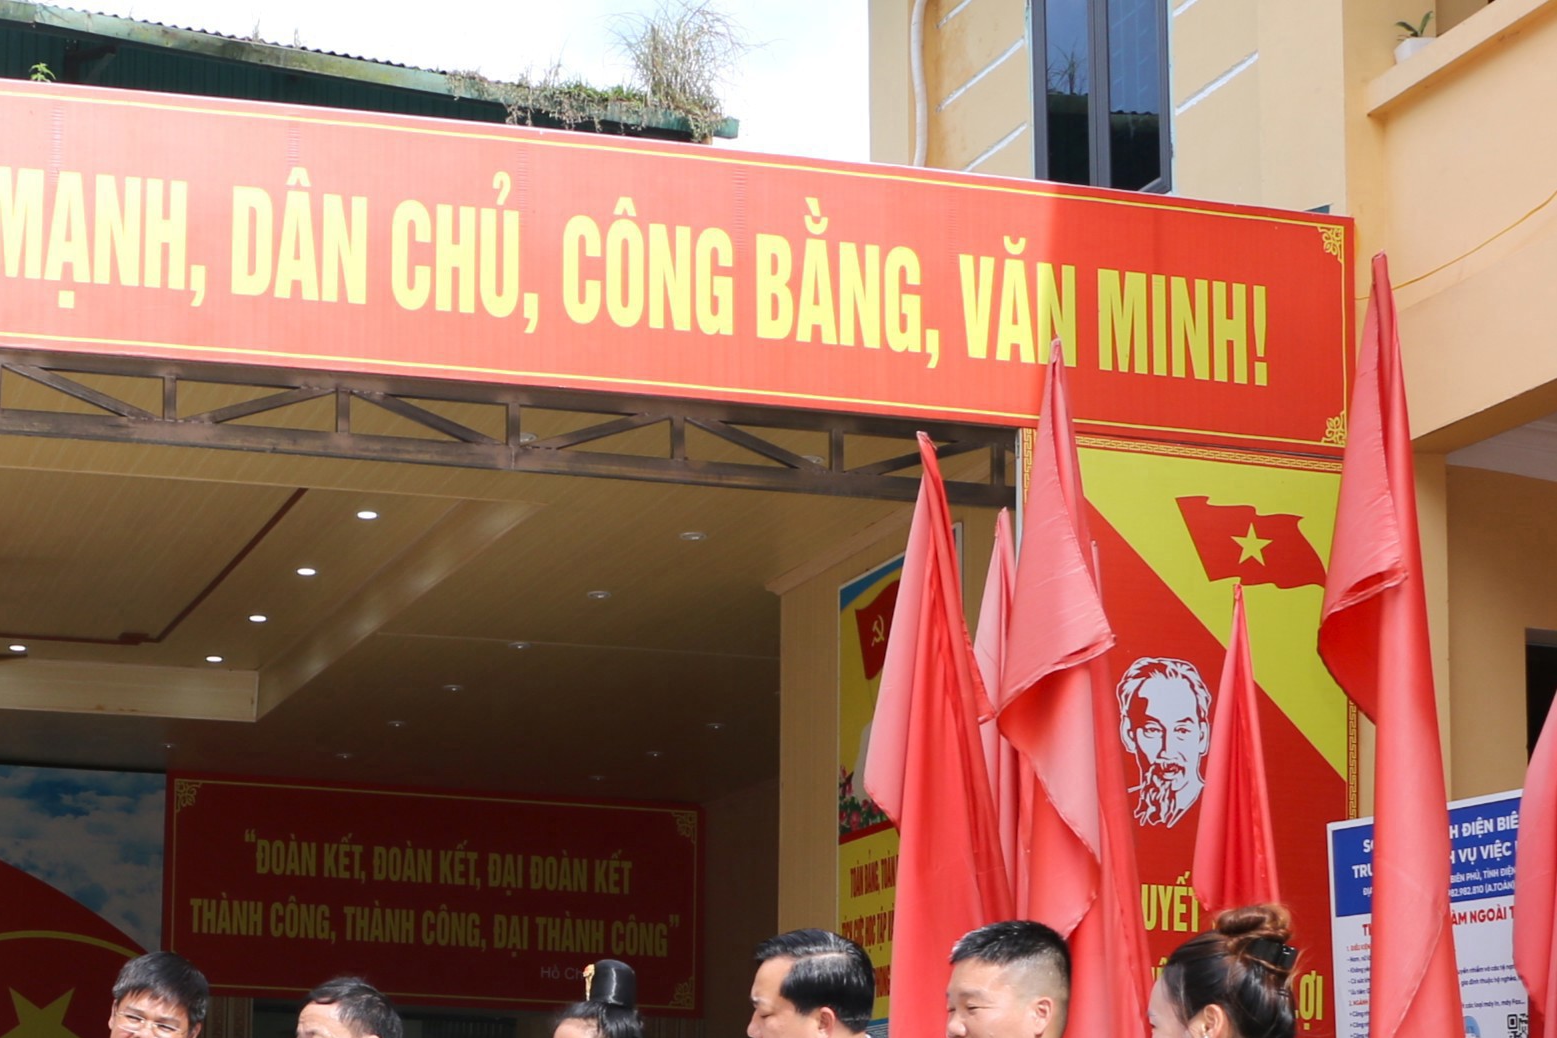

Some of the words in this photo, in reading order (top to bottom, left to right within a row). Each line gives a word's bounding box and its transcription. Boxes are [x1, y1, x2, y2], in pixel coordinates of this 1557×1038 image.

[232, 166, 369, 303] DÂN
[391, 172, 540, 333] CHỦ,
[563, 197, 734, 335] CÔNG
[756, 197, 940, 368] BẰNG,
[960, 234, 1077, 367] VĂN
[1098, 268, 1268, 387] MINH!
[1461, 816, 1494, 838] ĐIỆN
[1496, 810, 1520, 832] BIÊ
[1480, 839, 1512, 861] VIỆC
[324, 833, 366, 884] KẾT,
[373, 840, 432, 884] ĐOÀN
[440, 840, 481, 890] KẾT,
[488, 852, 523, 896] ĐẠI
[529, 850, 588, 892] ĐOÀN
[595, 849, 632, 894] KẾT
[190, 892, 263, 936] THÀNH
[270, 895, 336, 944] CÔNG,
[343, 900, 415, 944] THÀNH
[421, 904, 486, 951] CÔNG,
[493, 914, 529, 958] ĐẠI
[535, 911, 604, 954] THÀNH
[1141, 871, 1200, 932] UYẾT
[1469, 904, 1506, 924] NGOÀI
